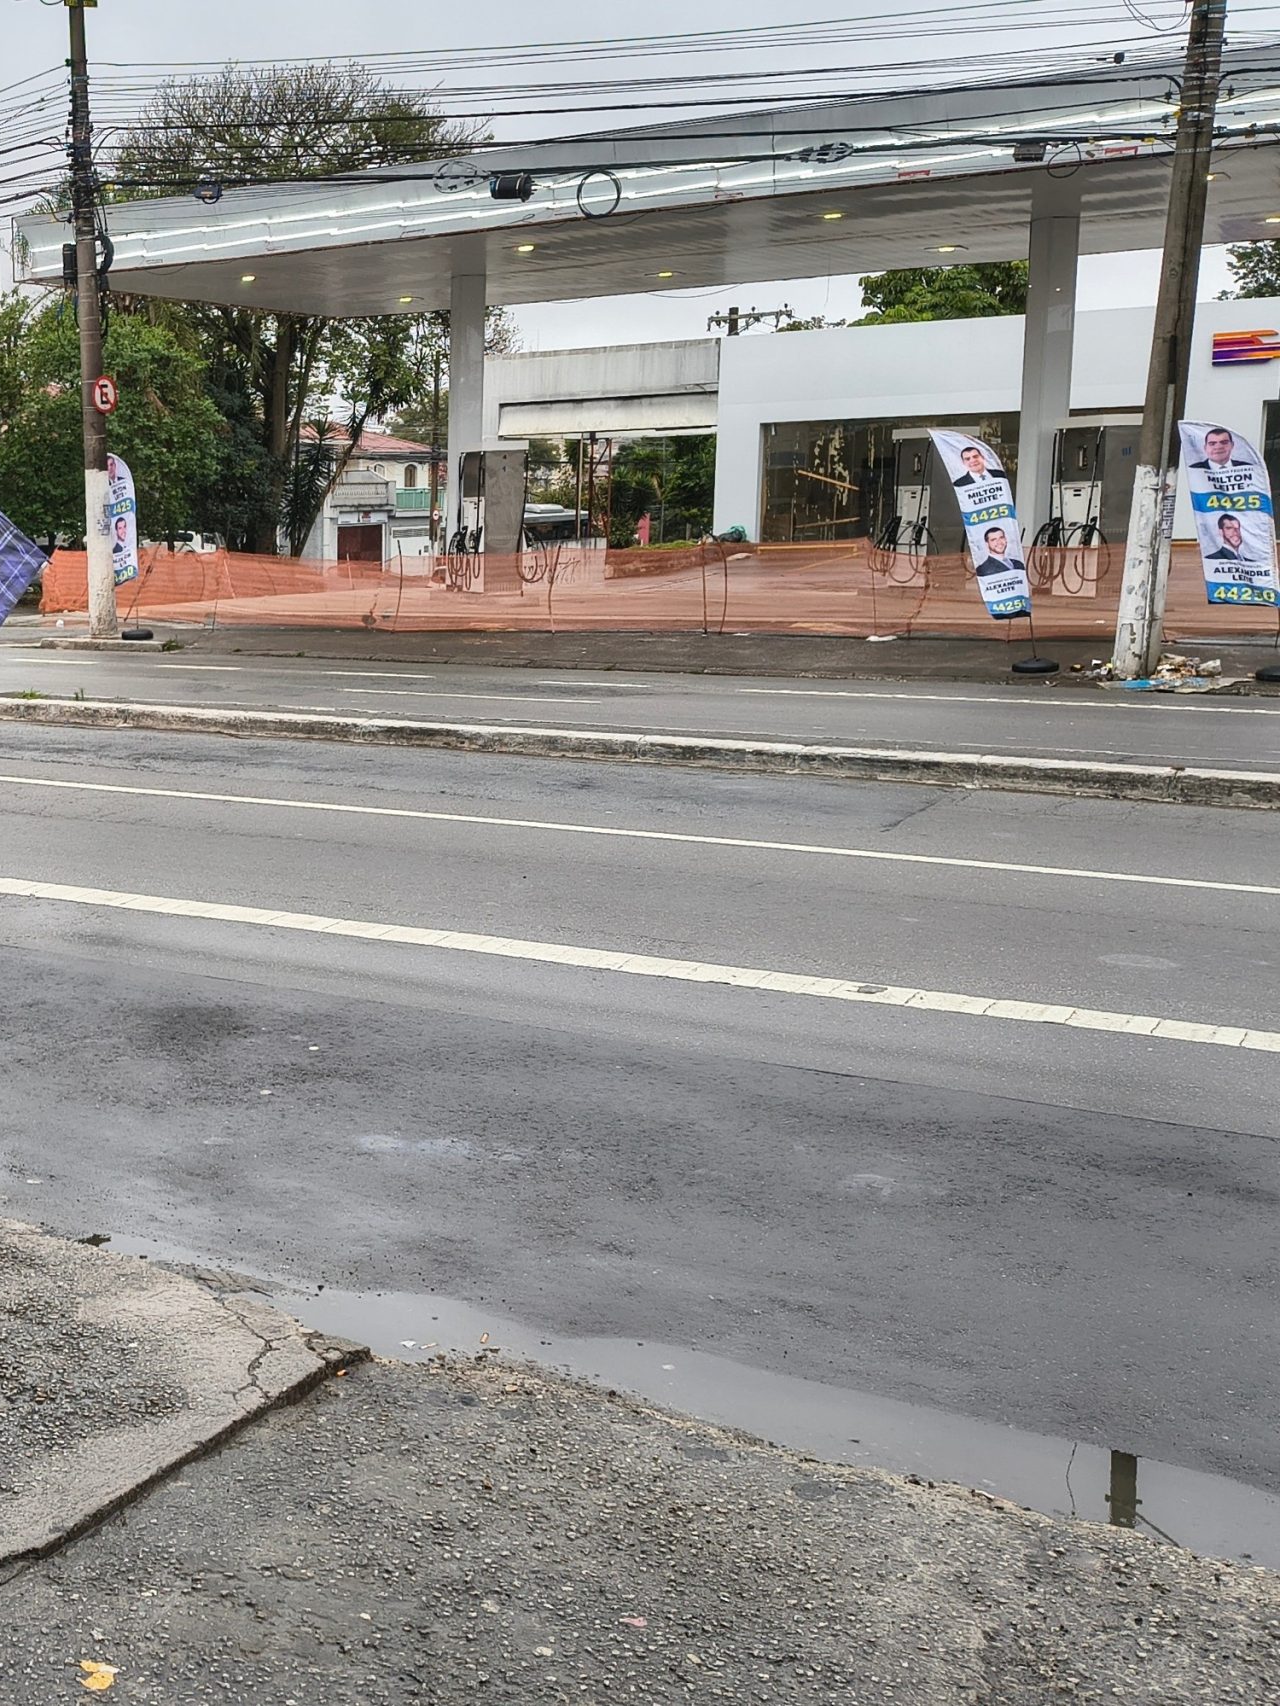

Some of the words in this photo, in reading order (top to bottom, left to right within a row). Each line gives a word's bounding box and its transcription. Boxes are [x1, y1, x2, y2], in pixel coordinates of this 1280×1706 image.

[1207, 473, 1252, 484] MILTON
[967, 486, 1003, 500] MILTON
[1213, 482, 1245, 492] LEITE
[973, 493, 999, 505] LEITE
[1206, 495, 1261, 510] 4425
[970, 505, 1009, 524] 4425
